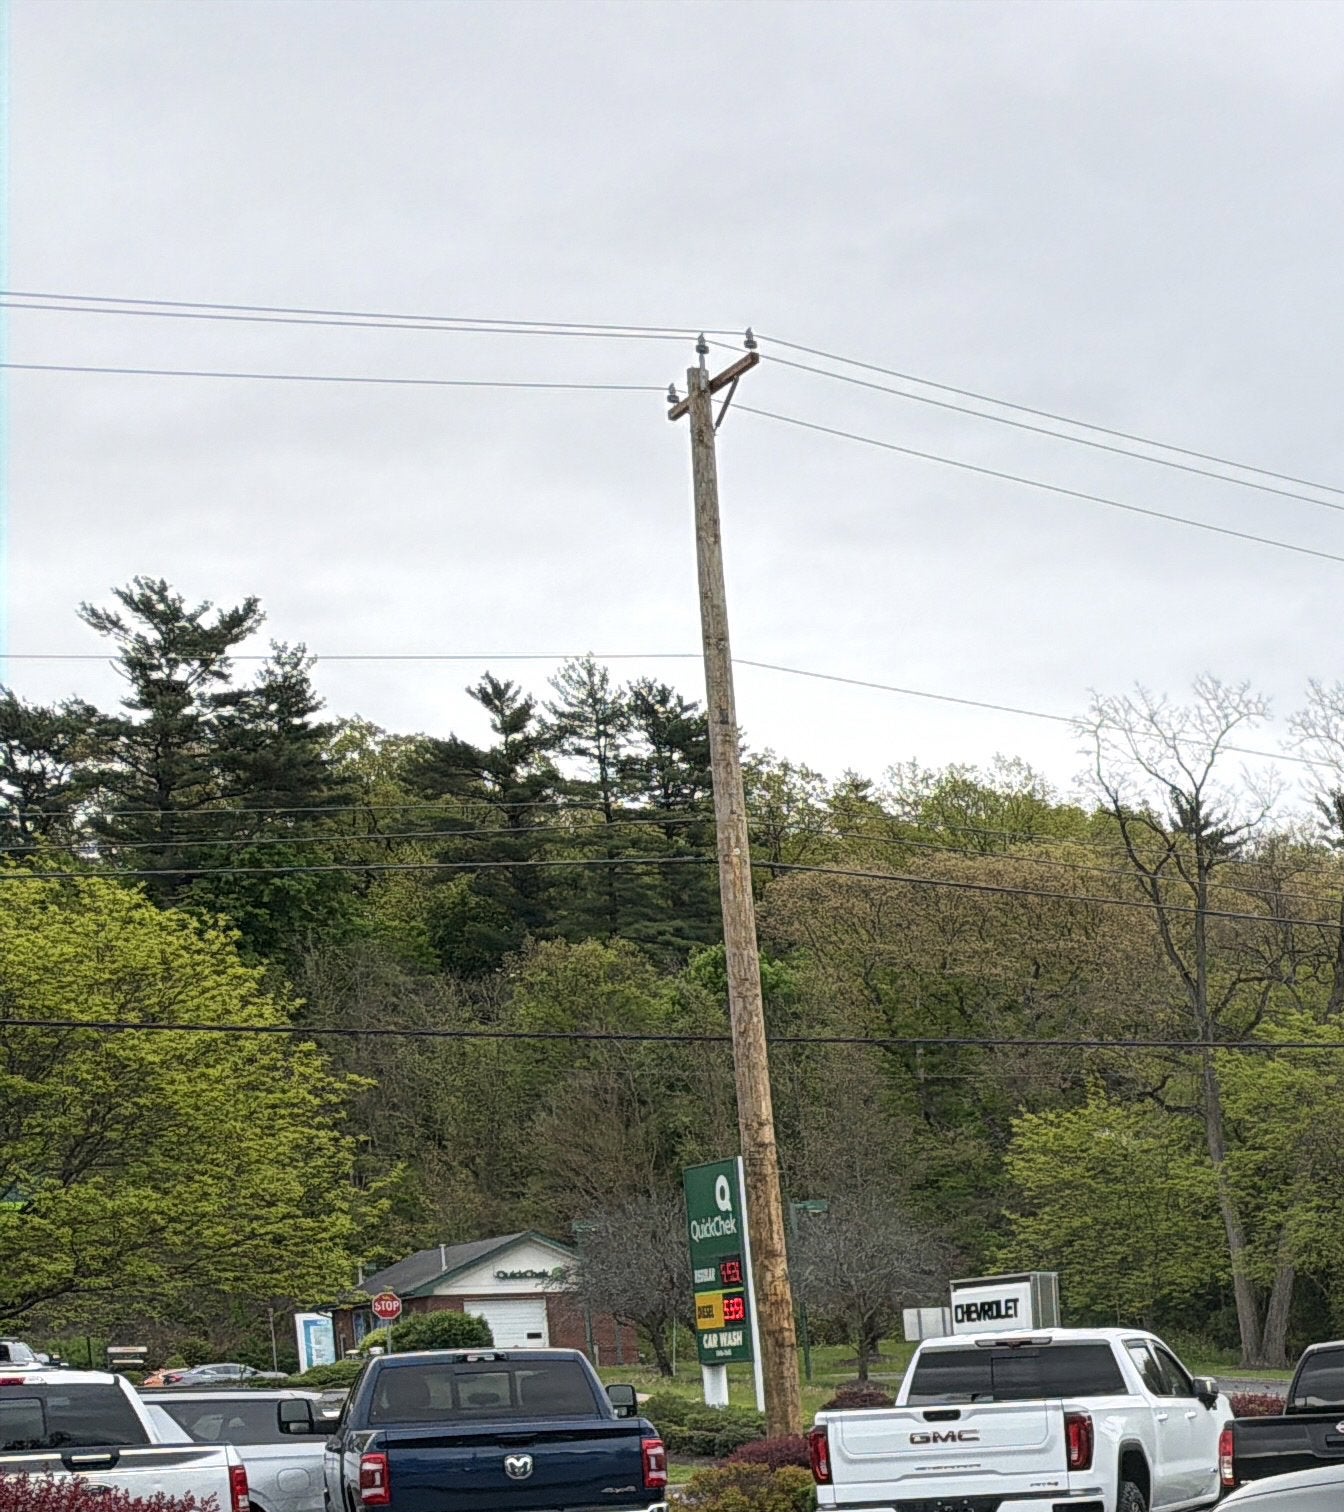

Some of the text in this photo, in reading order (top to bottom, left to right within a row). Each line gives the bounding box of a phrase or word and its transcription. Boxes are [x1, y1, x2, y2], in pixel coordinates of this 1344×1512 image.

[715, 1174, 732, 1211] Q
[690, 1213, 737, 1242] QuickChek
[374, 1300, 400, 1312] STOP
[954, 1297, 1019, 1324] CHEVROLET
[703, 1330, 743, 1349] CAR WASH
[909, 1428, 981, 1445] GMC
